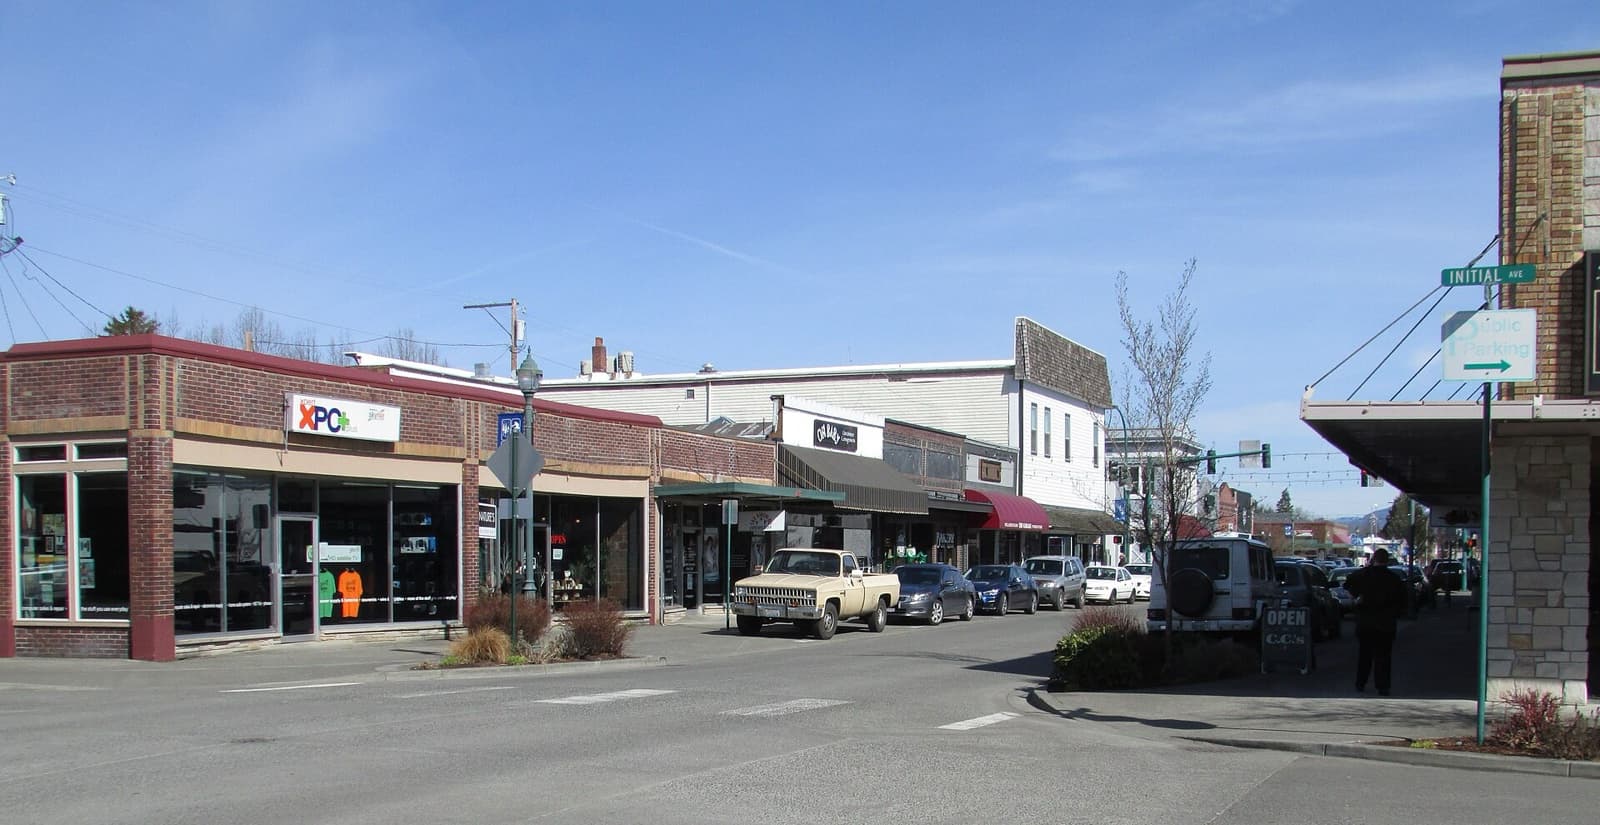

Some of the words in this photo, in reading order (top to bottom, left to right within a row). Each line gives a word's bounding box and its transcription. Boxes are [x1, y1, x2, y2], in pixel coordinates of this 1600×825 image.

[1449, 267, 1502, 284] INITIAL
[1508, 270, 1523, 279] AVE
[1463, 342, 1528, 358] Parking
[1267, 610, 1305, 626] OPEN
